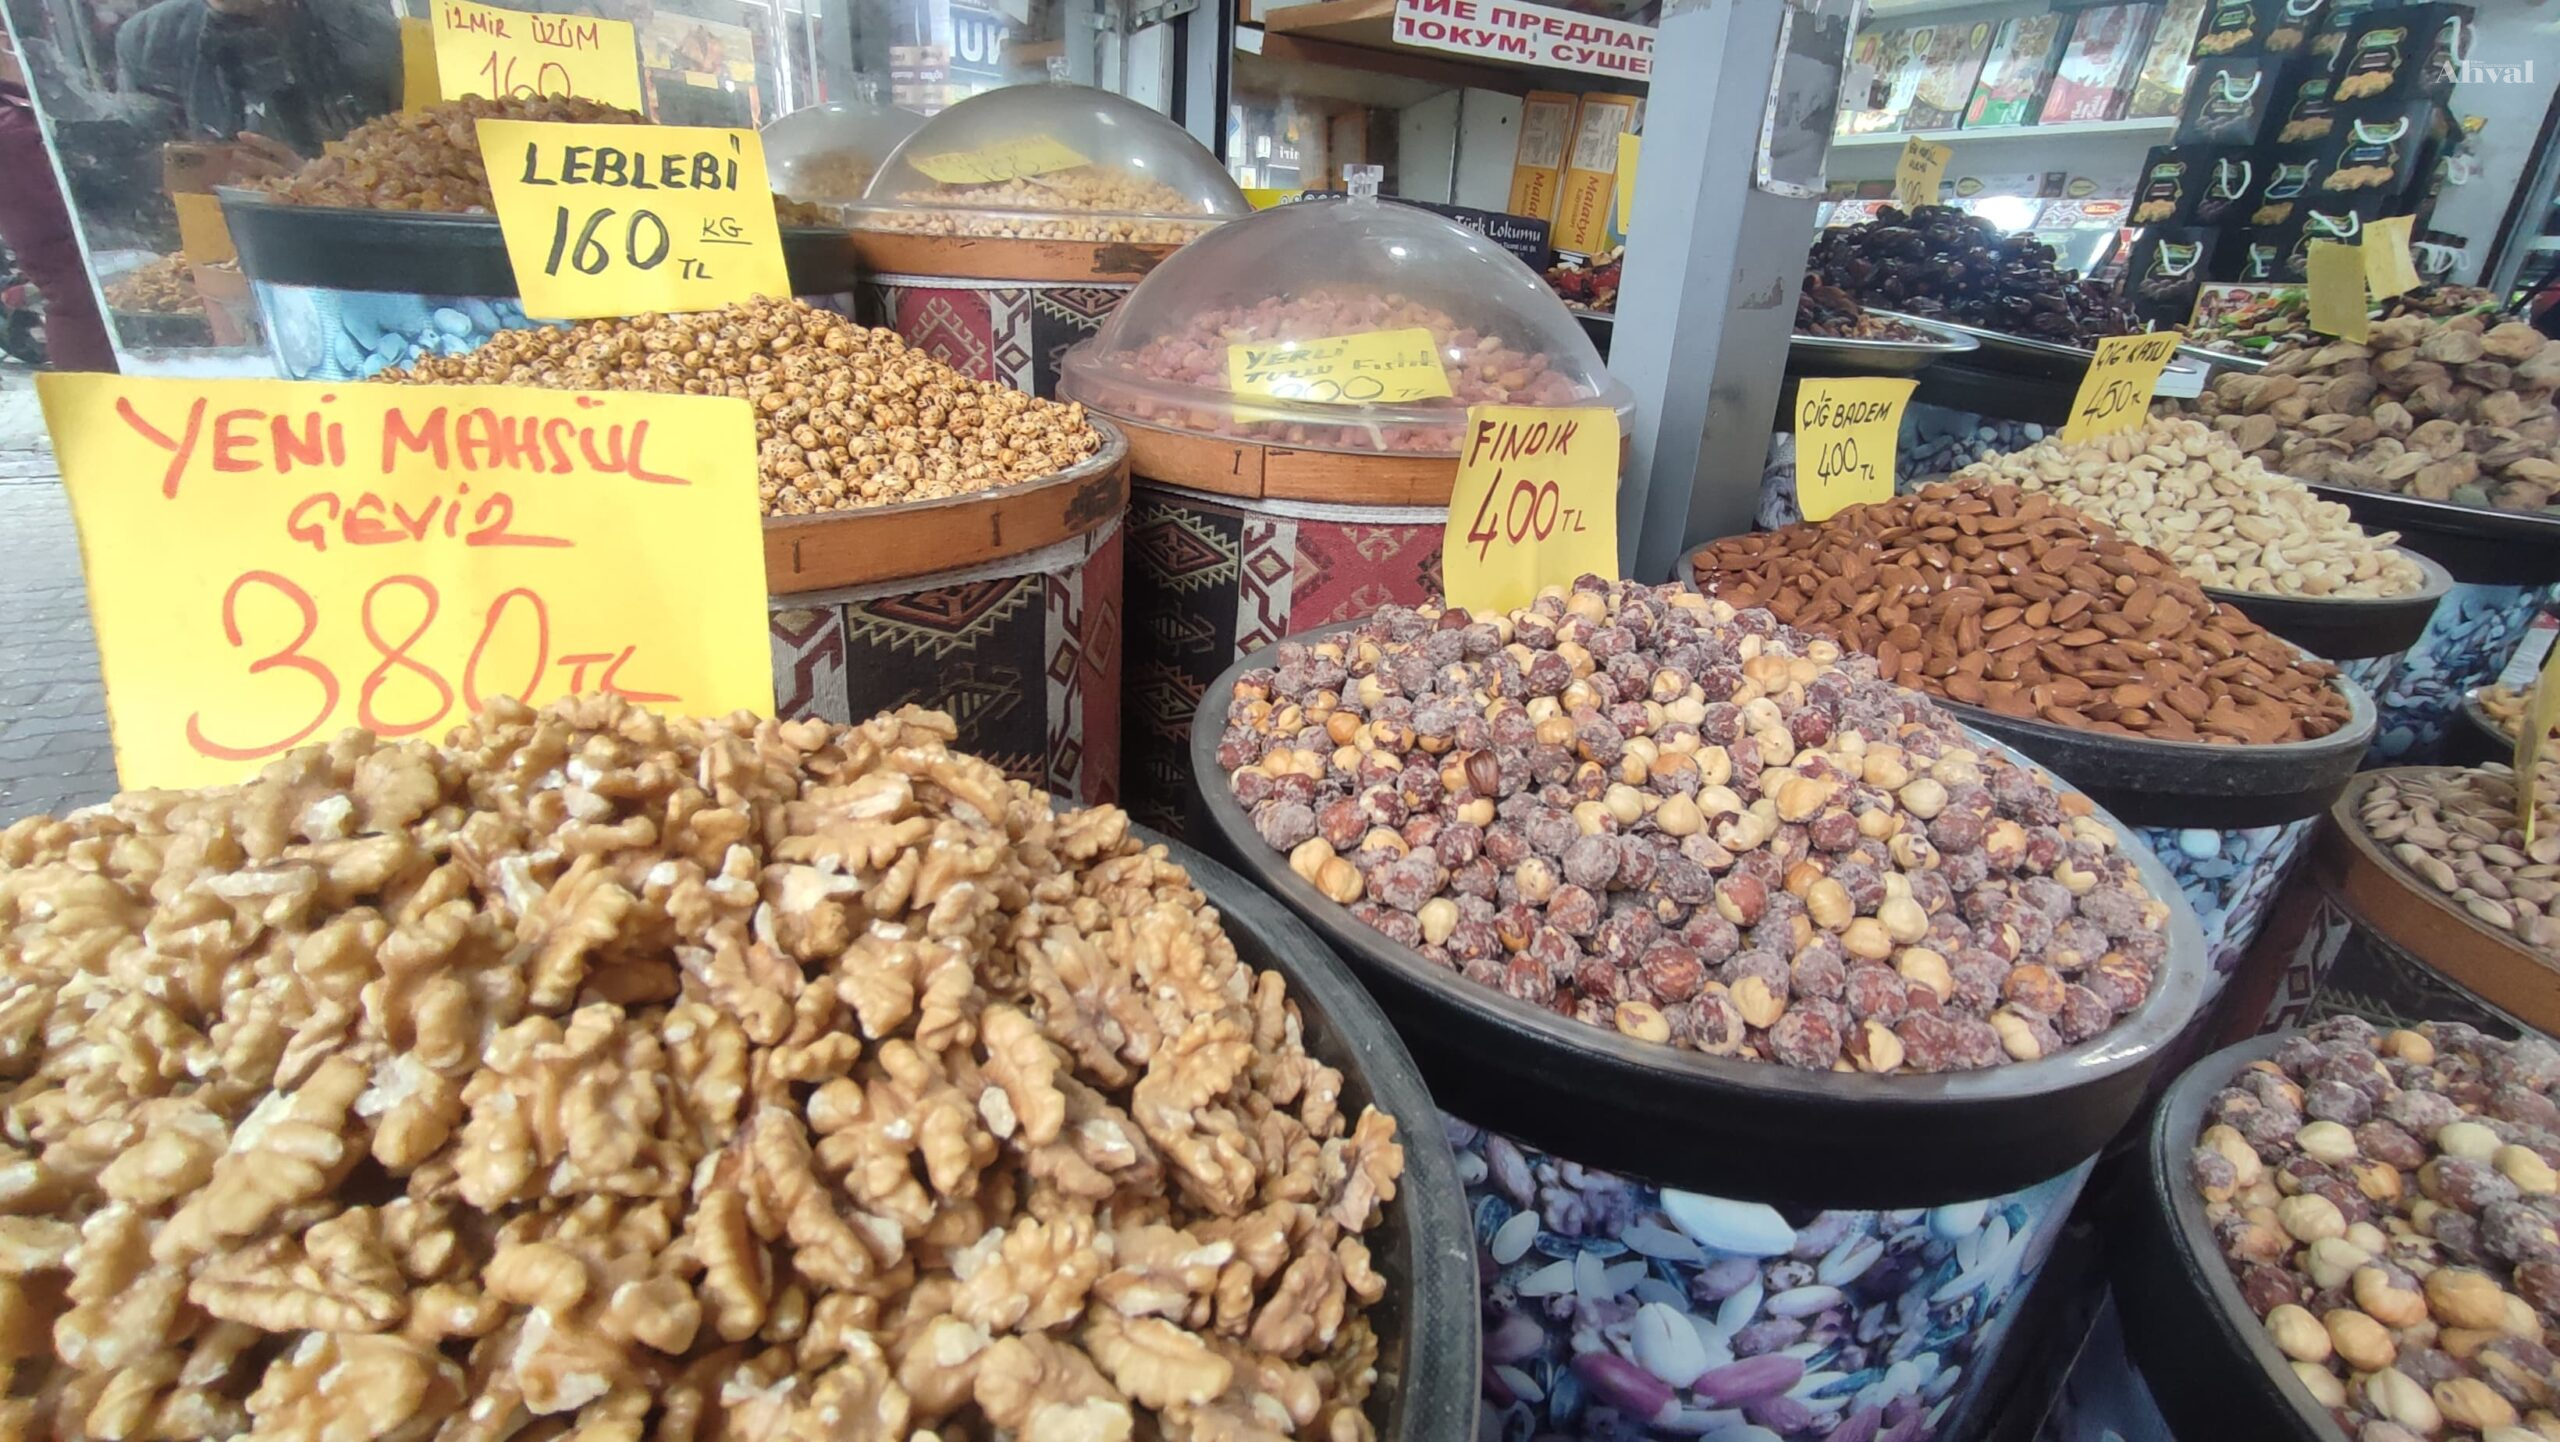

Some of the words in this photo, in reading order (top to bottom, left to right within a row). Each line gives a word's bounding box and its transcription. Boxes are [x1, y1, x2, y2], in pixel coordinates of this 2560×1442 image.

[1490, 7, 1656, 51] ПРЕДЛАГ
[480, 51, 572, 100] 160
[520, 134, 741, 191] LEBLEBİ
[702, 216, 744, 238] KG
[1489, 219, 1542, 243] Lokumu
[1574, 176, 1599, 245] Malatya
[545, 206, 670, 277] 160
[678, 258, 714, 280] TL
[1832, 401, 1893, 430] BADEM
[2083, 376, 2134, 427] 450
[116, 394, 346, 500] YENİ
[382, 396, 693, 486] MAHSÜL
[1468, 420, 1579, 468] FINDIK
[1818, 437, 1859, 487] 400
[1467, 467, 1560, 563] 400
[1562, 509, 1587, 532] TL
[186, 570, 549, 761] 380
